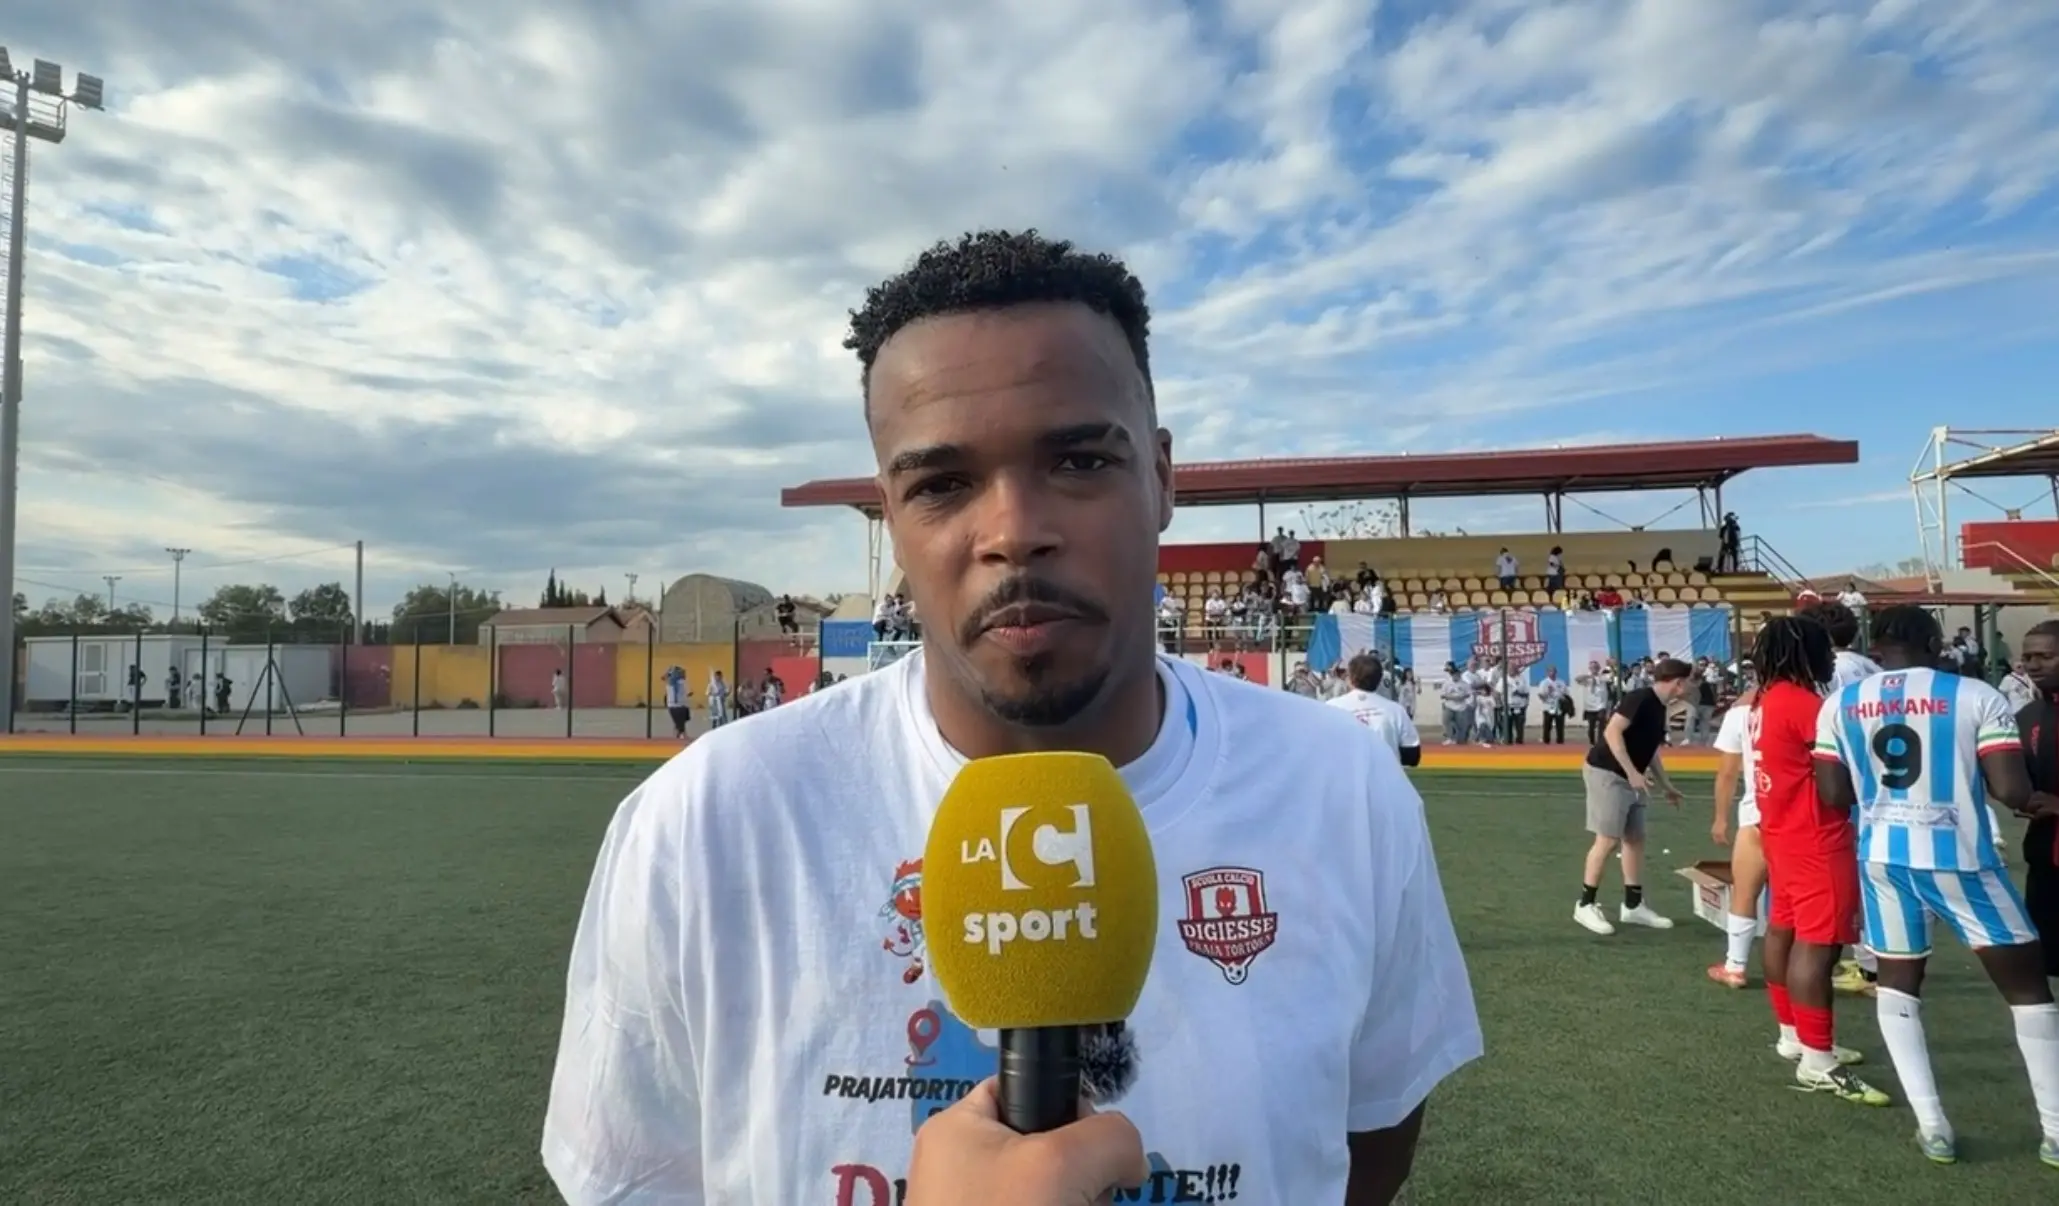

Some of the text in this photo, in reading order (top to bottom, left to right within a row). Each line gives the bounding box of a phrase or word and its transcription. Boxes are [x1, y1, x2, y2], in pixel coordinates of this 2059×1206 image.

[1473, 643, 1545, 657] DIGESSE
[1846, 697, 1949, 720] THIAKANE
[1872, 723, 1922, 789] 9
[961, 837, 996, 864] LA
[963, 902, 1097, 955] sport
[1183, 917, 1274, 941] DIGIESSE
[823, 1074, 984, 1103] PRAJATORTO
